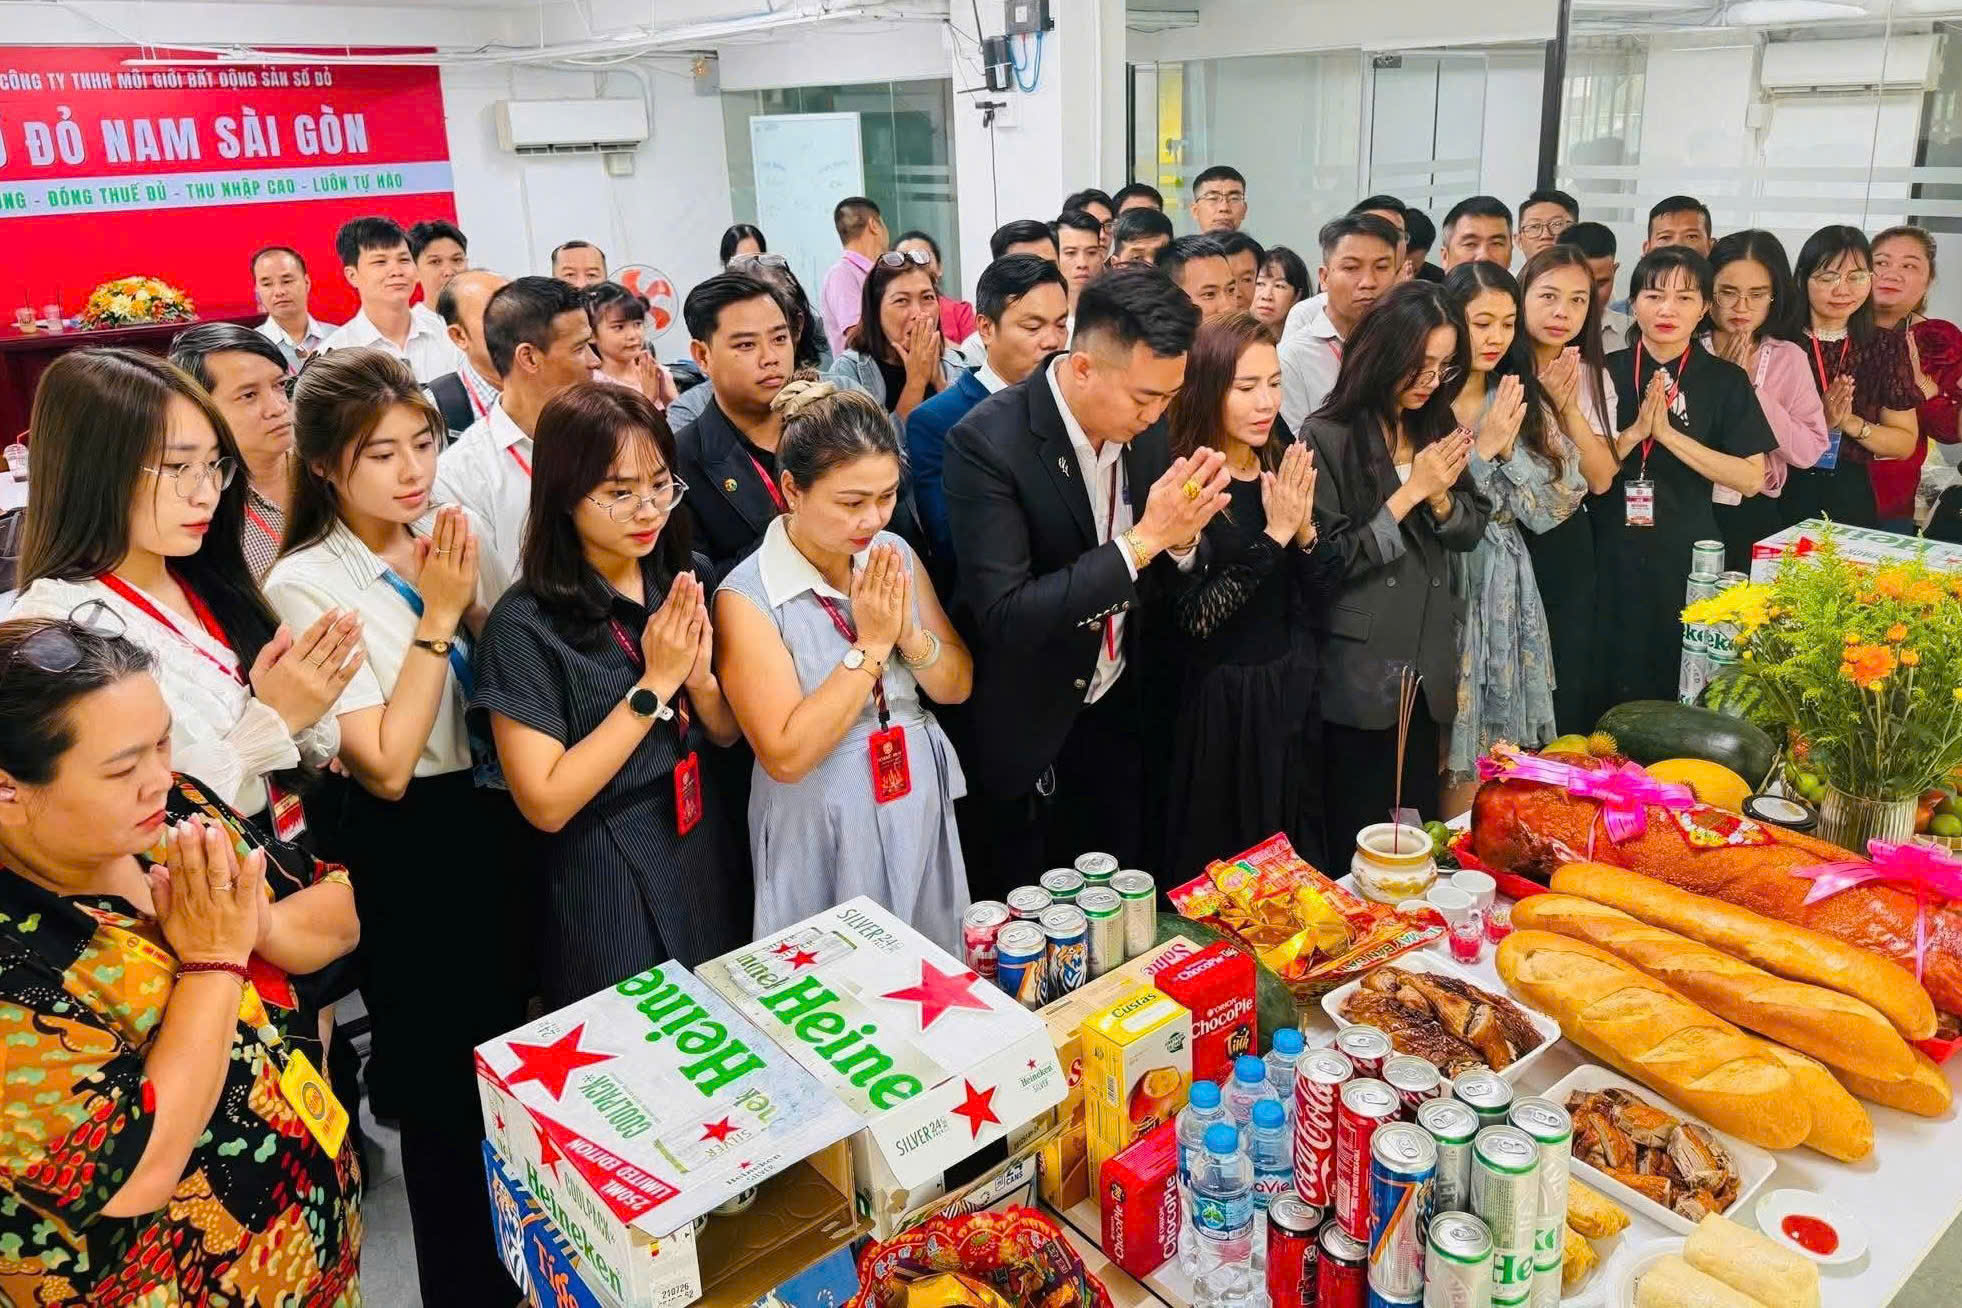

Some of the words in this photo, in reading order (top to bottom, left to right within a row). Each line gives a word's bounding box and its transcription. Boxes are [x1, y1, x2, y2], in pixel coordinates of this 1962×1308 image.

[0, 69, 42, 90] CÔNG
[47, 72, 65, 90] TY
[71, 72, 112, 90] TNHH
[24, 105, 86, 166] ĐỎ
[101, 118, 200, 163] NAM
[215, 104, 281, 159] SÀI
[294, 104, 369, 156] GÒN
[48, 186, 93, 207] ĐÓNG
[186, 183, 215, 199] THU
[221, 178, 261, 200] NHẬP
[267, 179, 295, 195] CAO
[313, 173, 347, 192] LUÔN
[837, 908, 884, 940] SILVER
[1111, 992, 1157, 1019] Custas
[578, 1074, 653, 1140] COOLPACK
[566, 1138, 618, 1172] EDITION
[706, 1129, 753, 1158] SILVER
[896, 1127, 933, 1157] SILVER
[616, 1162, 675, 1200] LIMITED
[1005, 1170, 1024, 1187] CANS
[1254, 1180, 1290, 1194] aVie
[602, 1180, 652, 1211] 250ML
[524, 1155, 626, 1302] Heineken
